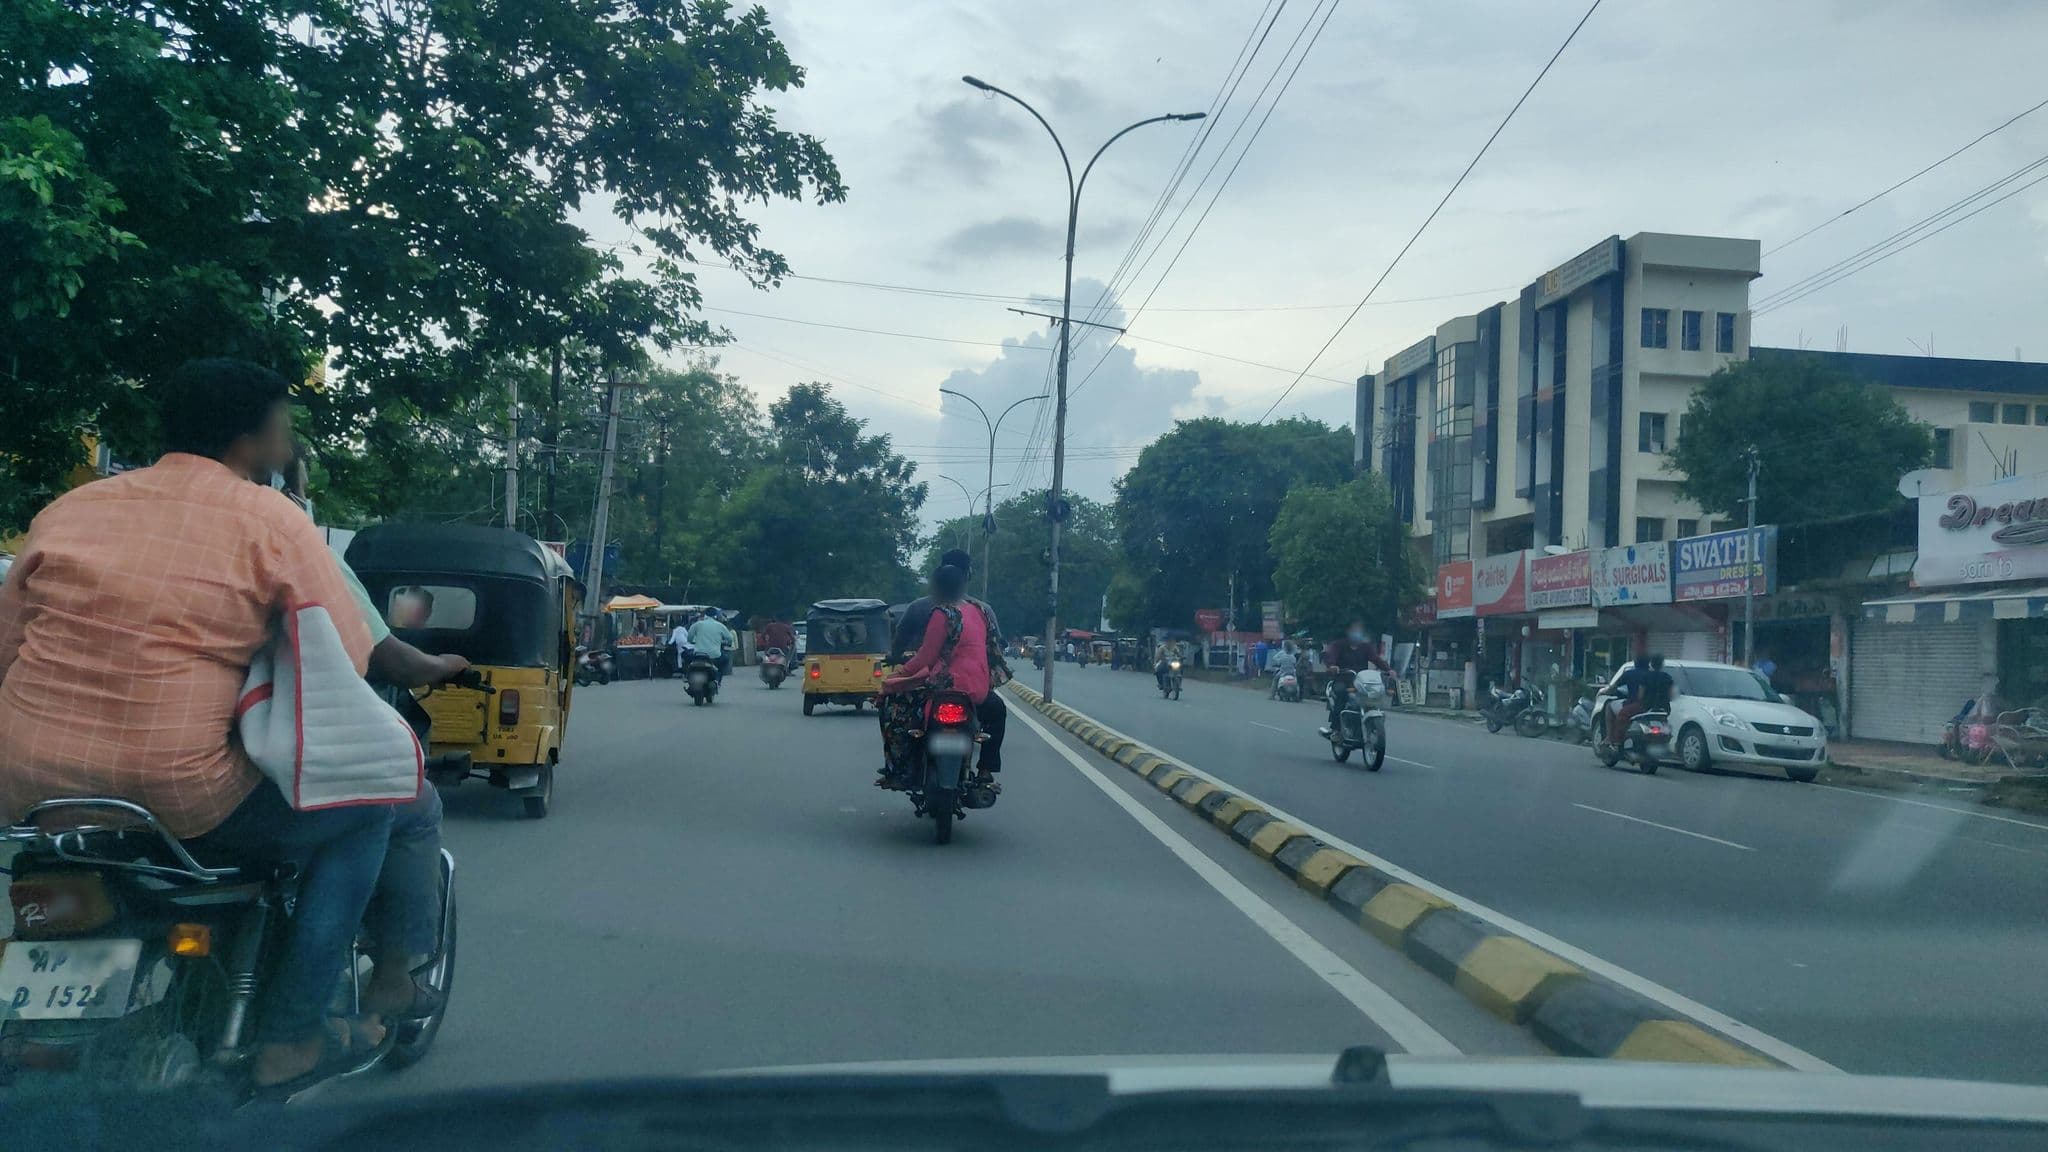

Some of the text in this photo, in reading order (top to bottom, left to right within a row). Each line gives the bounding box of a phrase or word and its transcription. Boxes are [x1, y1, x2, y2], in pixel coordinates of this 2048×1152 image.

[1680, 533, 1761, 571] SWATHI
[1485, 564, 1508, 588] airtel
[1613, 562, 1667, 587] SURGICALS
